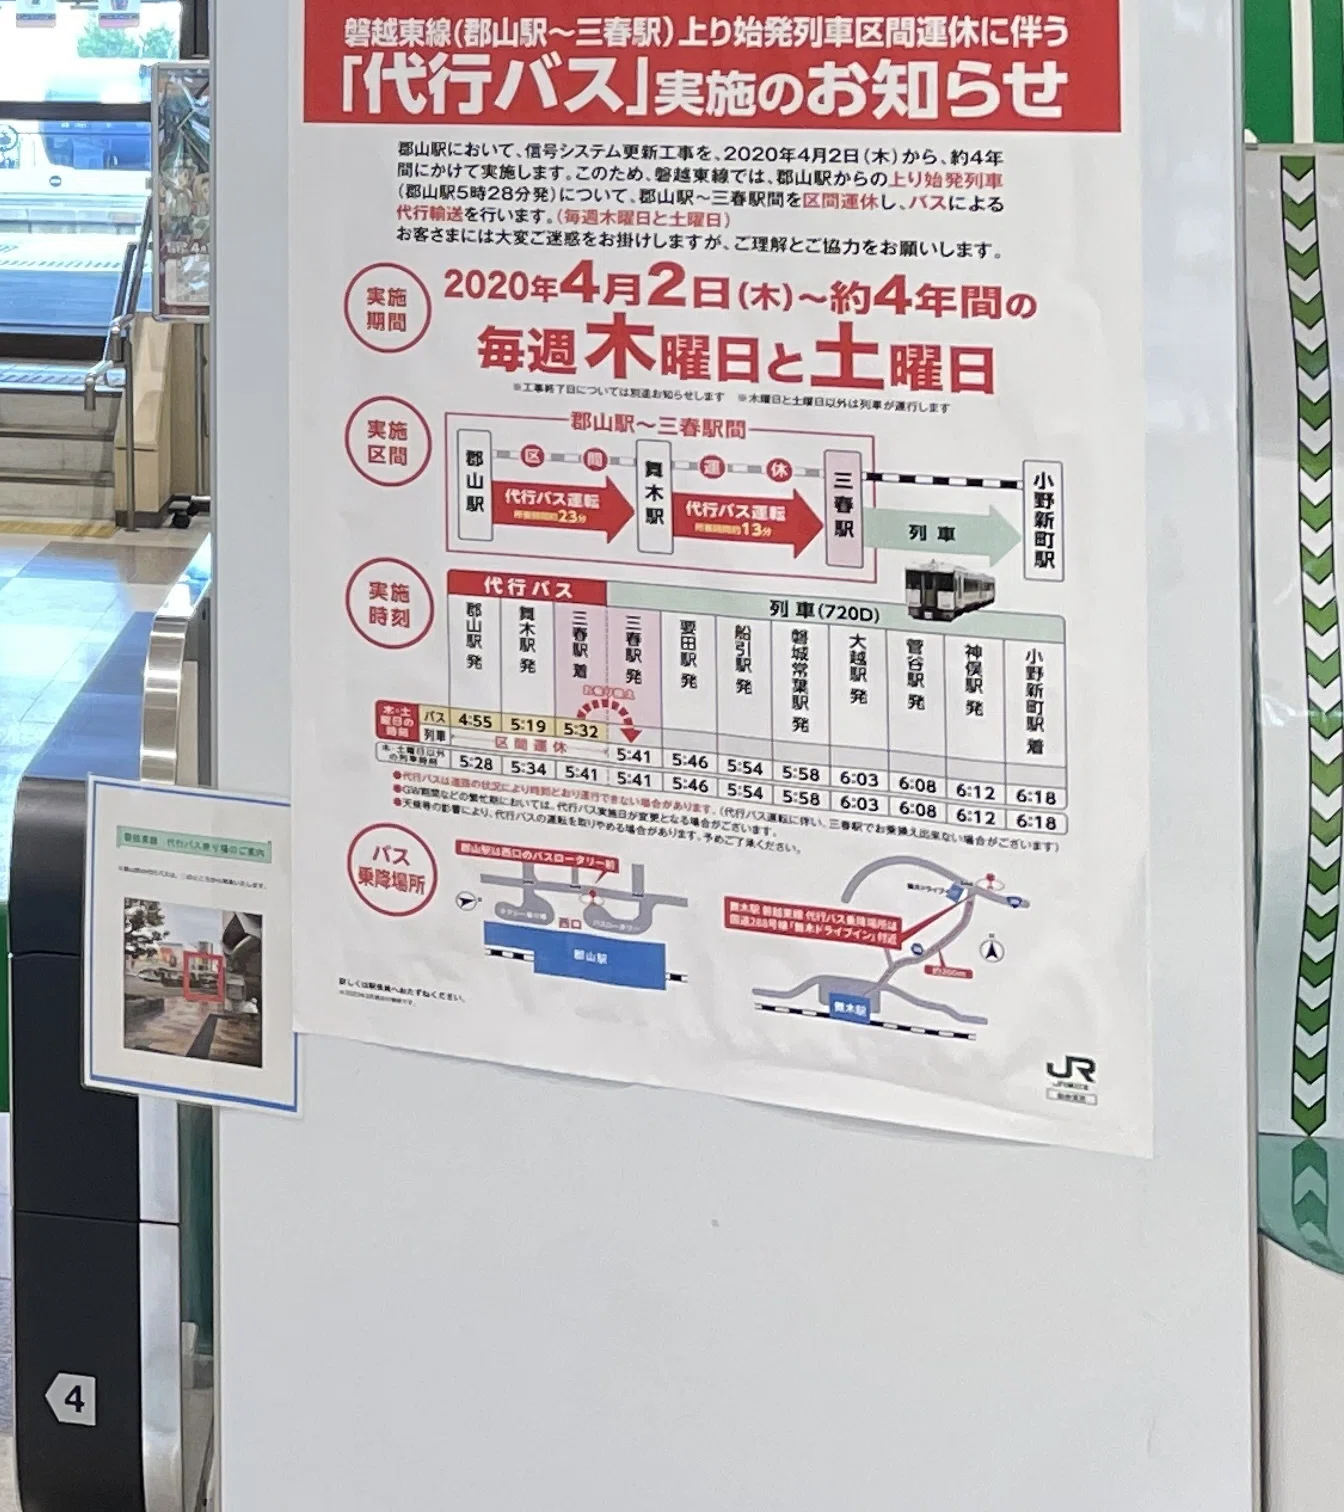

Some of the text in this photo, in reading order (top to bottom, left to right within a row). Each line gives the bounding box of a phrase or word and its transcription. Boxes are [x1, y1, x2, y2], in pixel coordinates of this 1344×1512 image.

[366, 287, 408, 307] 実施
[366, 311, 408, 333] 期間
[478, 312, 994, 395] 毎週木曜日と土曜日
[367, 419, 409, 440] 実施
[367, 444, 409, 466] 区間
[465, 449, 485, 513] 郡山駅
[504, 489, 600, 509] 代行バス運転
[685, 500, 786, 522] 代行バス運転
[834, 471, 854, 538] 三春駅
[1034, 471, 1055, 569] 小野新町駅
[369, 580, 410, 604] 実施
[483, 575, 573, 600] 代行バス
[369, 606, 410, 629] 時刻
[424, 710, 599, 739] バス 4:55 5:19 5:32
[616, 748, 652, 764] 5:41
[672, 753, 709, 769] 5:46
[727, 759, 764, 776] 5:54
[782, 765, 821, 782] 5:58
[840, 771, 879, 787] 6:03
[899, 777, 937, 794] 6:08
[956, 783, 996, 800] 6:12
[1016, 788, 1057, 806] 6:18
[372, 845, 411, 866] バス
[357, 867, 426, 895] 乗降場所
[1046, 1055, 1097, 1083] JR
[63, 1383, 86, 1414] 4
